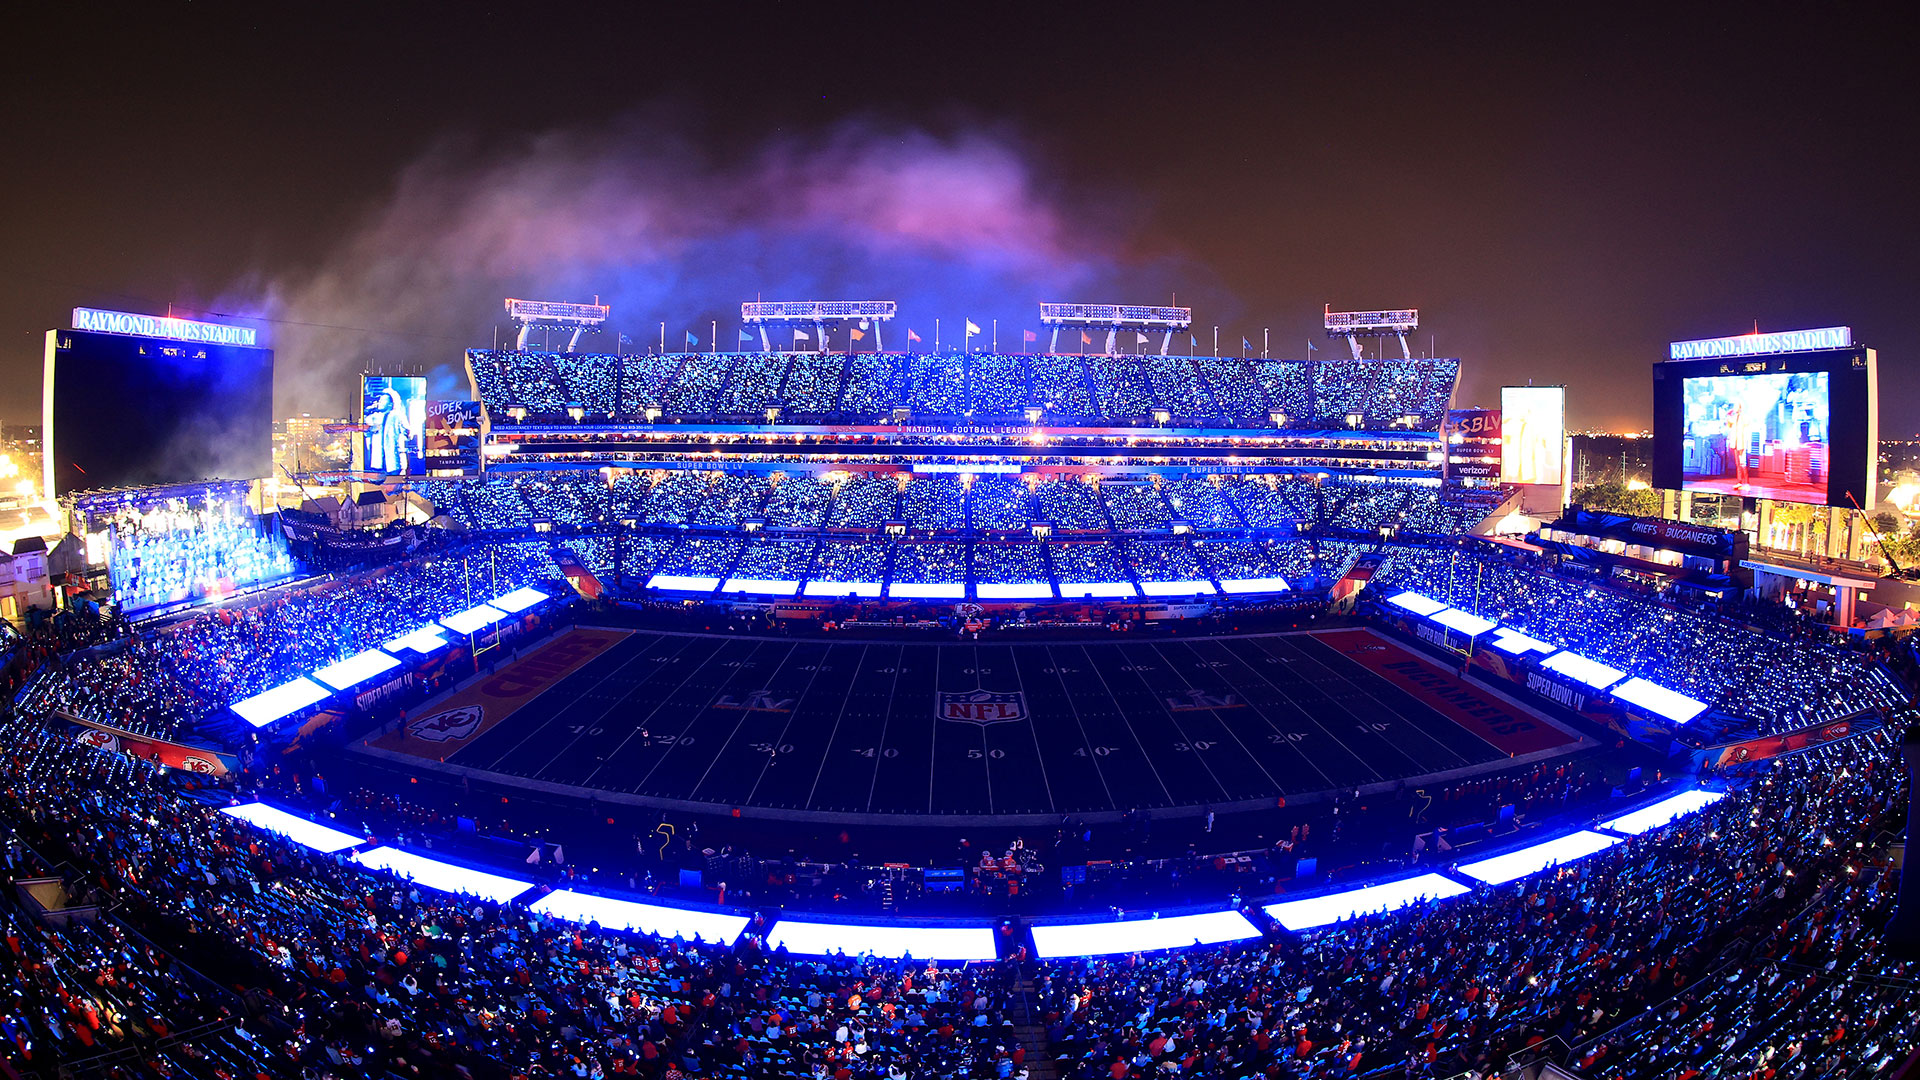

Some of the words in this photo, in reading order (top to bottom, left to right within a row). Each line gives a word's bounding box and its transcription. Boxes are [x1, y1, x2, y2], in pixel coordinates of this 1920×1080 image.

[79, 309, 156, 336] RAYMOND
[156, 318, 200, 340] JAMES
[201, 324, 257, 346] STADIUM
[1671, 340, 1735, 360] RAYMOND
[1736, 334, 1781, 355] JAMES
[1781, 328, 1847, 351] STADIUM
[428, 400, 463, 418] SUPER
[446, 410, 475, 425] BOWL
[952, 426, 996, 434] FOOTBALL
[1458, 466, 1489, 475] verizon
[1631, 522, 1658, 535] CHIEFS
[1665, 527, 1718, 545] BUCCANEERS
[1417, 623, 1433, 642] SUPER
[356, 688, 381, 712] SUPER
[382, 677, 403, 700] BOWL
[404, 672, 414, 687] LV
[1526, 671, 1551, 695] SUPER
[1551, 684, 1573, 707] BOWL
[1573, 694, 1585, 712] LV
[949, 702, 1018, 721] NFL
[656, 735, 696, 746] 20
[1267, 732, 1303, 744] 20
[861, 747, 899, 758] 40
[967, 749, 1005, 759] 50
[1073, 745, 1111, 757] 40
[1174, 741, 1210, 752] 30
